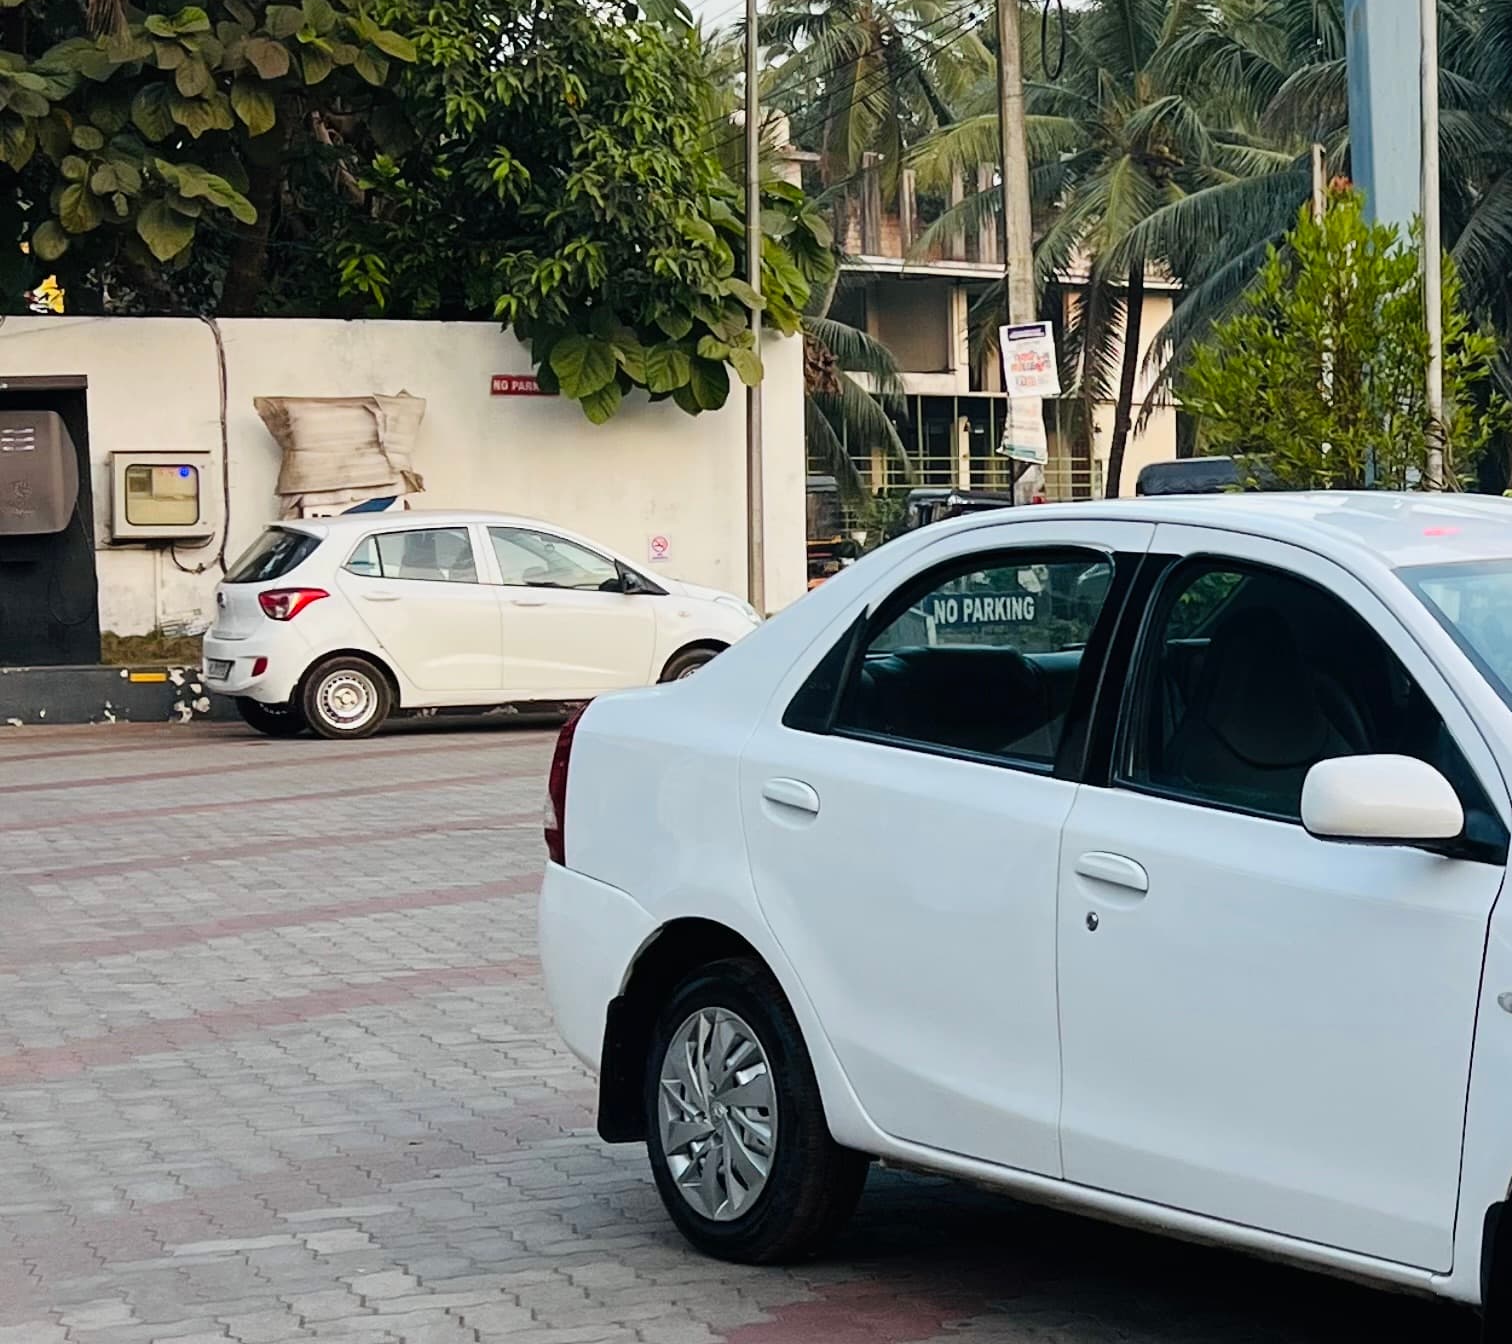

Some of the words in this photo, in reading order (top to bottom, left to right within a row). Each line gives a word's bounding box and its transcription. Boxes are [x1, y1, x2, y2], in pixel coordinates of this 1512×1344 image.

[493, 379, 508, 391] NO
[933, 598, 958, 625] NO
[963, 596, 1035, 623] PARKING
